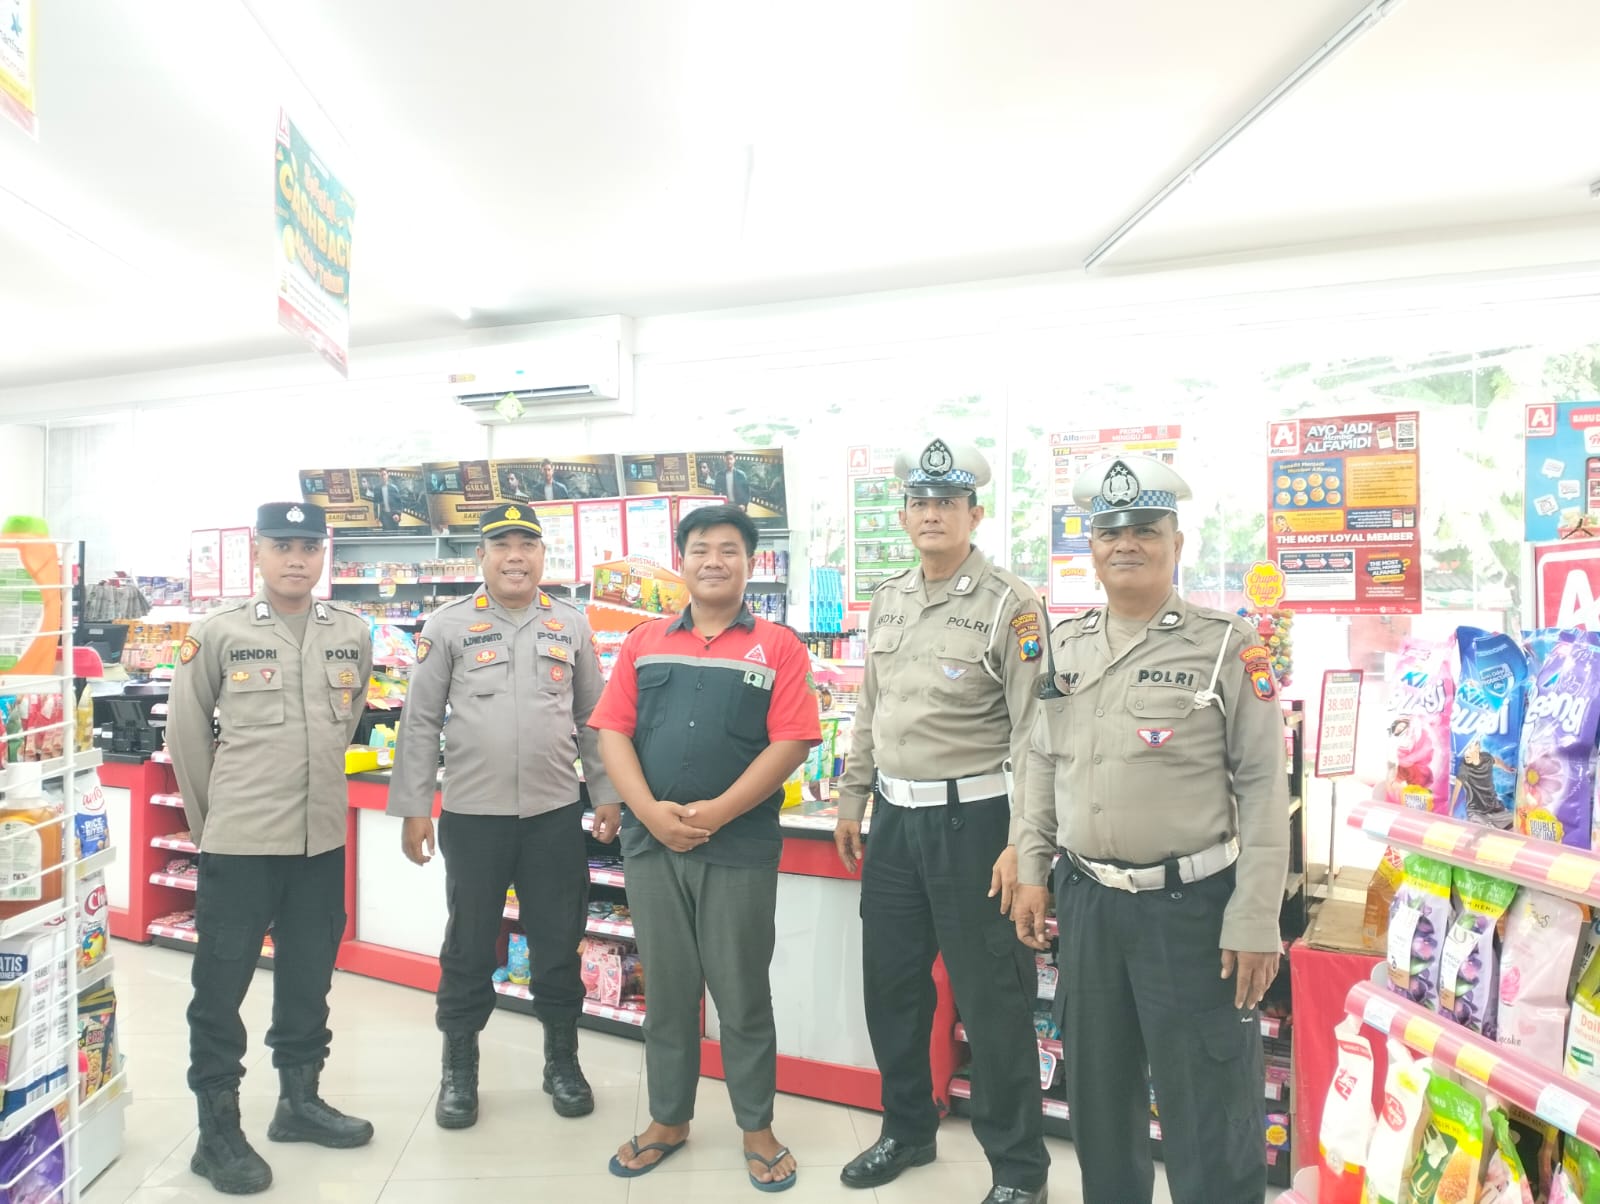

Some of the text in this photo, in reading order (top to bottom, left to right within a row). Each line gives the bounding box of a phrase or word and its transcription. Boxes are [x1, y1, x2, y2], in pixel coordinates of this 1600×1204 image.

[1307, 423, 1373, 438] AYO JADI
[1303, 436, 1372, 454] ALFAMIDI
[1275, 532, 1414, 544] THE MOST LOYAL MEMBER
[946, 616, 990, 634] POLRI
[536, 632, 573, 645] POLRI
[229, 649, 278, 661] HENDRI
[325, 649, 359, 660] POLRI
[1138, 669, 1194, 687] POLRI
